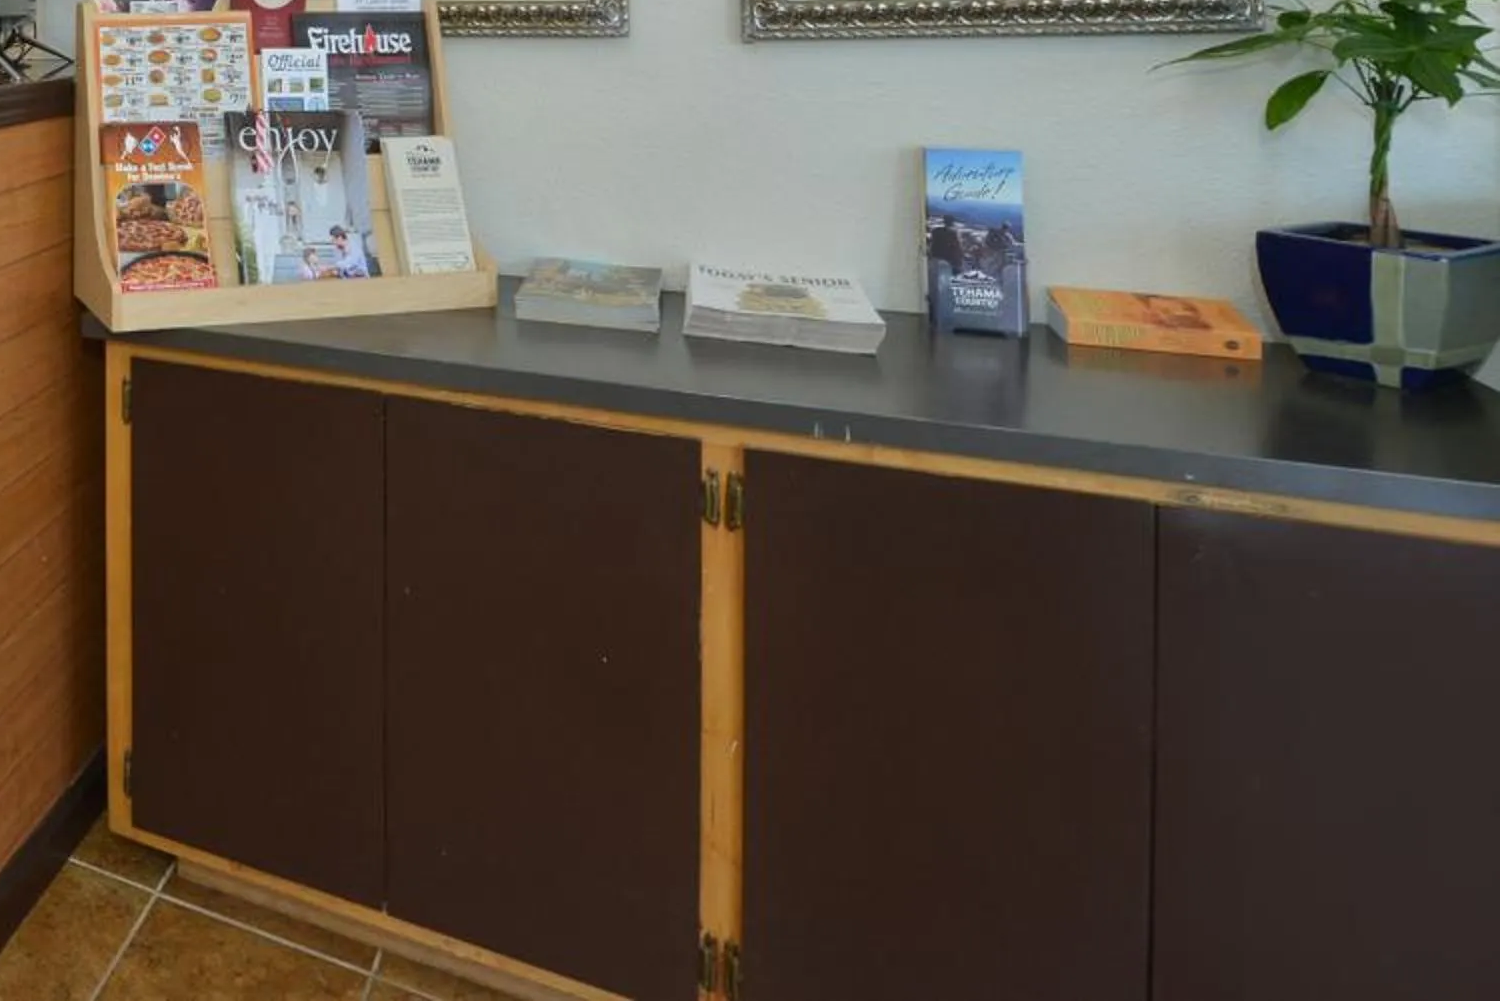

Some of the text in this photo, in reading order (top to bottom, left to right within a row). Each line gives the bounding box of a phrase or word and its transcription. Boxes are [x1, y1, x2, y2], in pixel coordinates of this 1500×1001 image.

[268, 53, 321, 69] Official
[239, 125, 338, 169] enjoy
[776, 275, 851, 288] SENIOR
[951, 286, 1003, 300] TEHAMA
